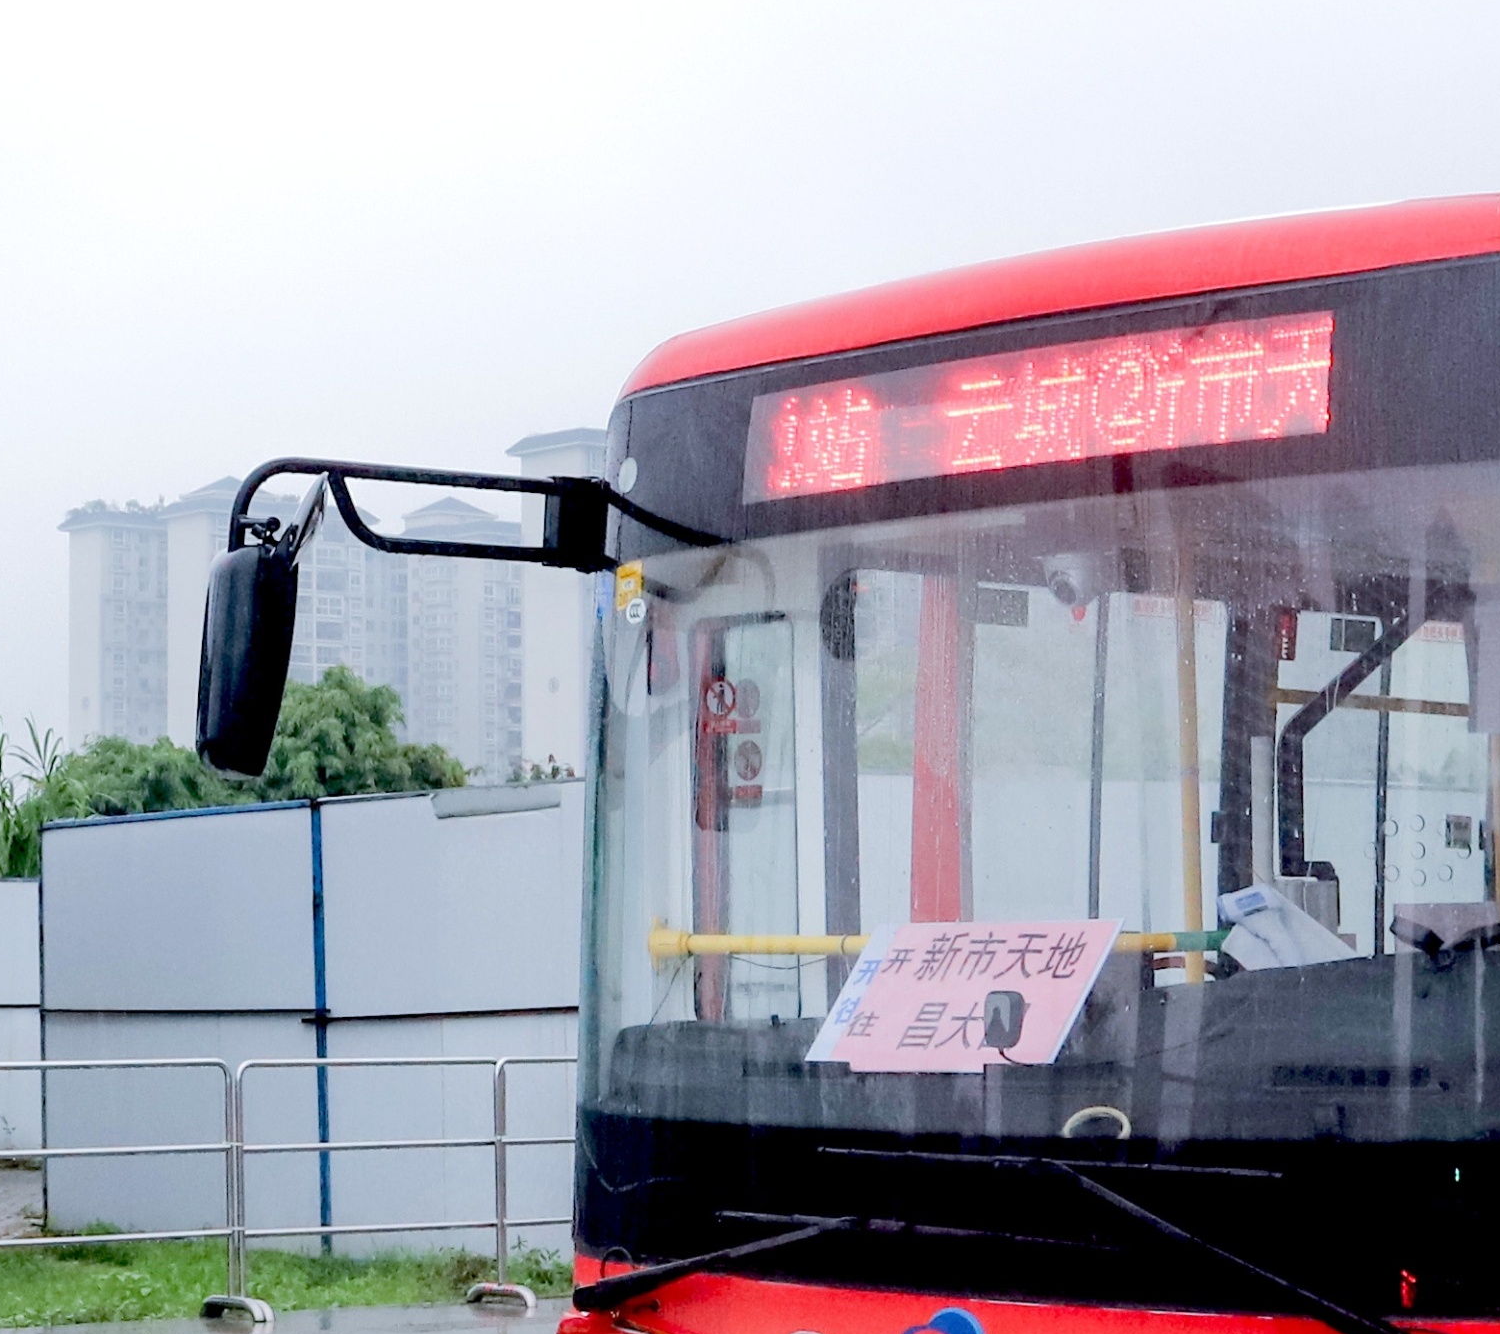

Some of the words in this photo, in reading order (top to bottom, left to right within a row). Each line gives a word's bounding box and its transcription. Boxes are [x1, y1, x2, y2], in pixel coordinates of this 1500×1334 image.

[916, 931, 1088, 981] 新市天地
[896, 1002, 1031, 1051] 昌大
